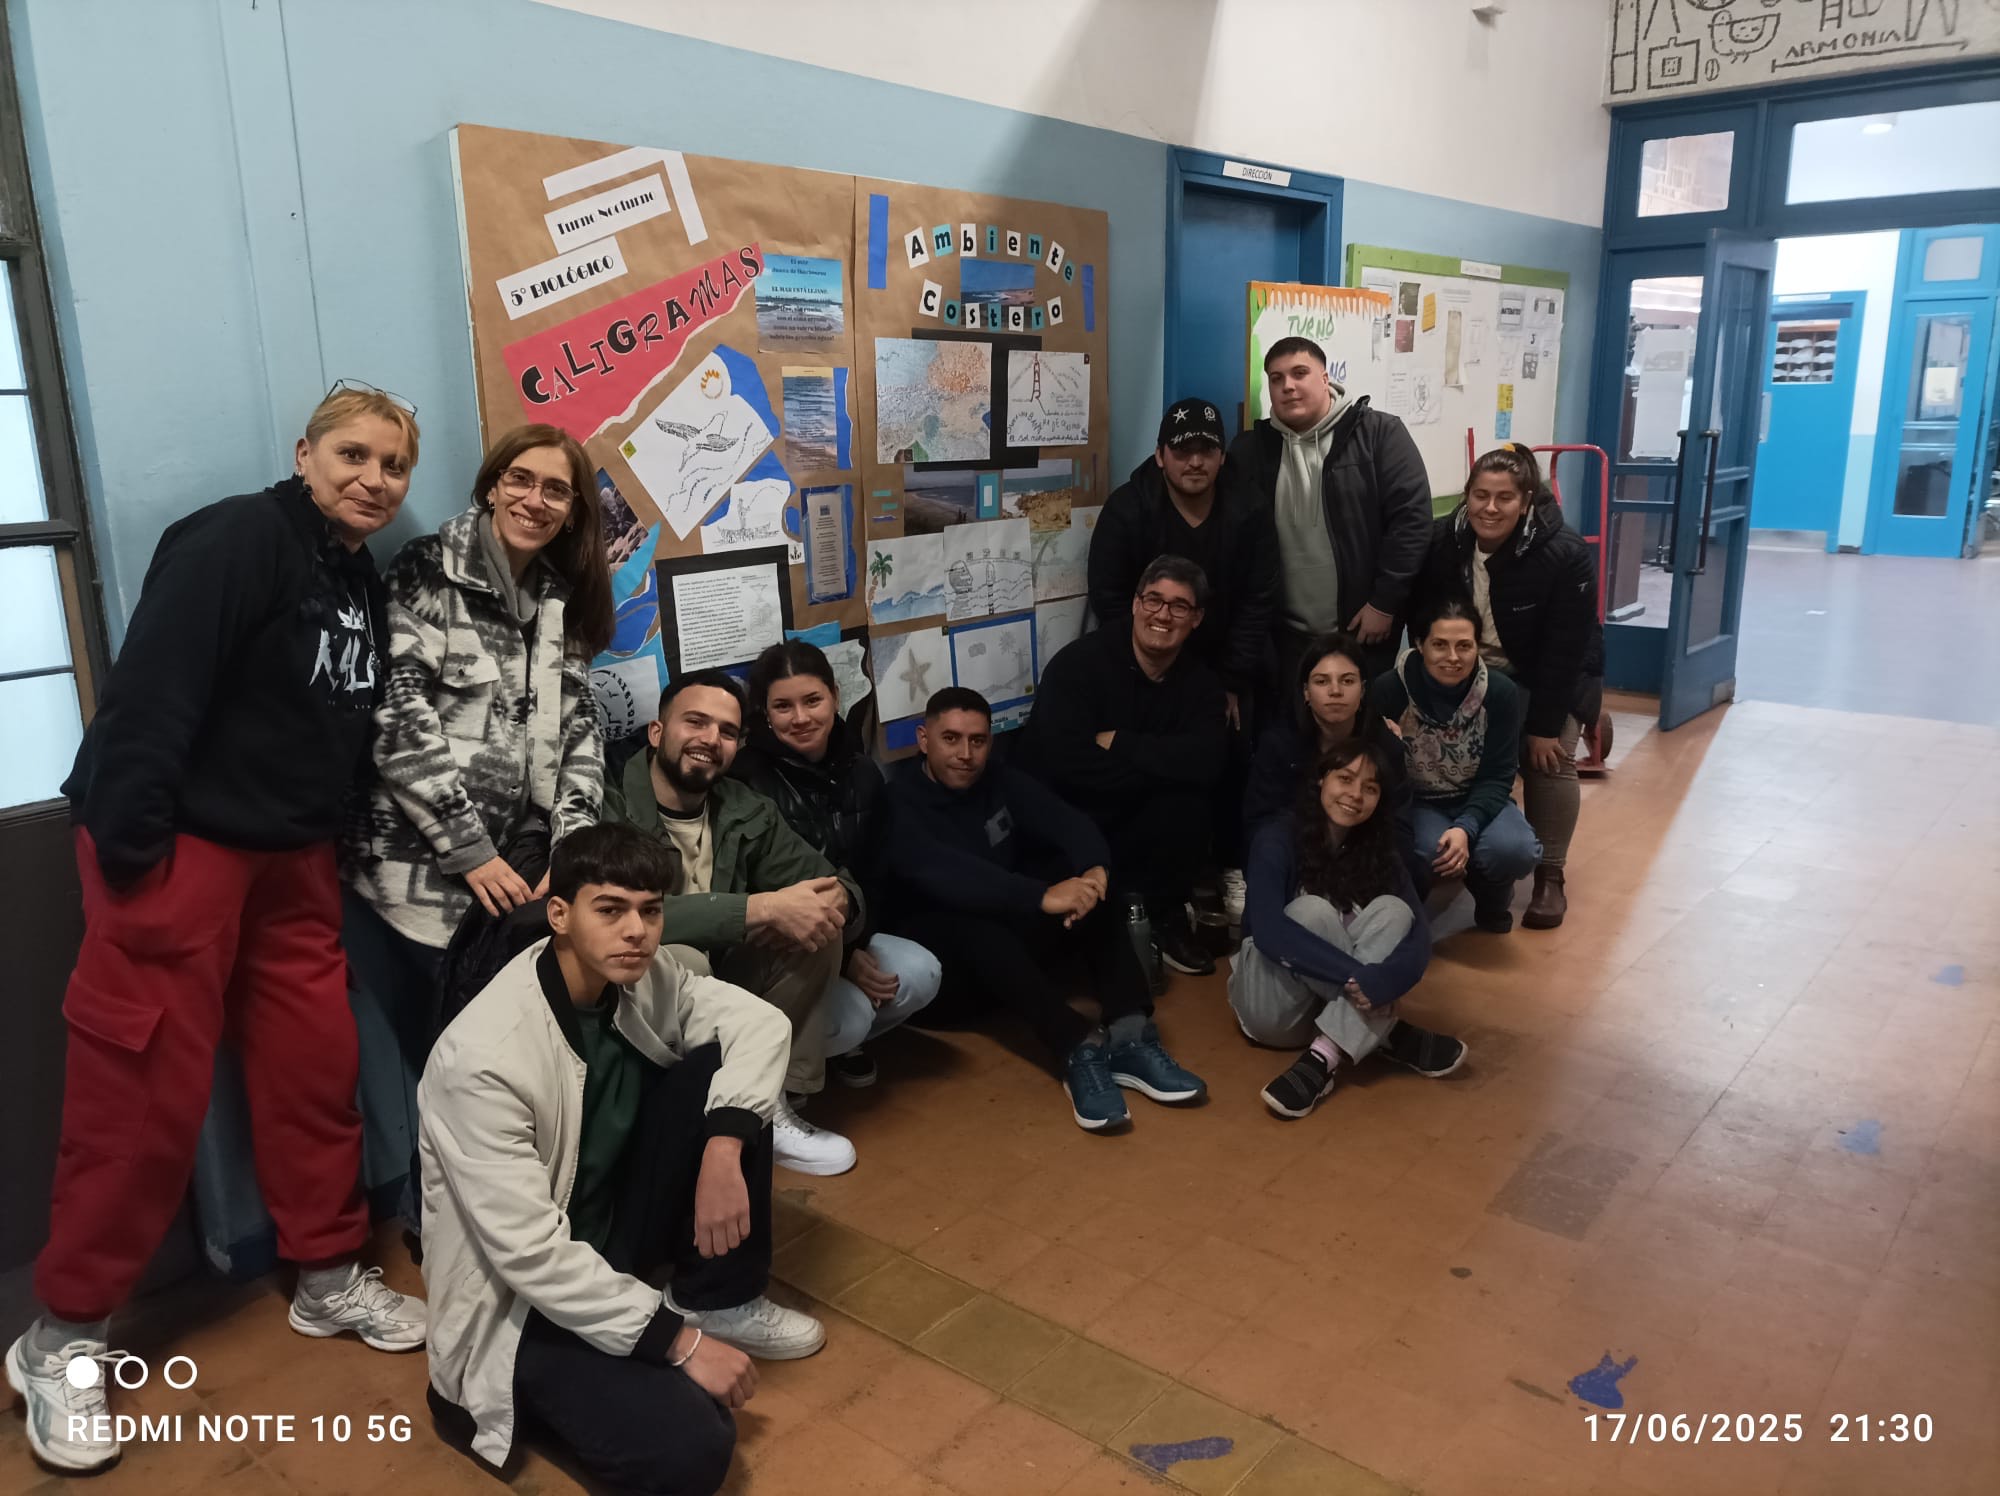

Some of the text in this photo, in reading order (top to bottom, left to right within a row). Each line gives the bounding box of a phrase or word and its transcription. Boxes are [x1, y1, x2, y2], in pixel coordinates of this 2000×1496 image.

[1785, 29, 1902, 59] ARMONIA
[1242, 167, 1273, 181] DIRECCIÓN
[557, 191, 655, 235] Turno Nocturno
[910, 229, 1073, 281] Ambiente
[529, 255, 614, 299] BIOLÓGICO
[520, 246, 760, 405] CALIGRAMAS
[922, 289, 1061, 328] Costero
[1287, 313, 1335, 337] TURNO
